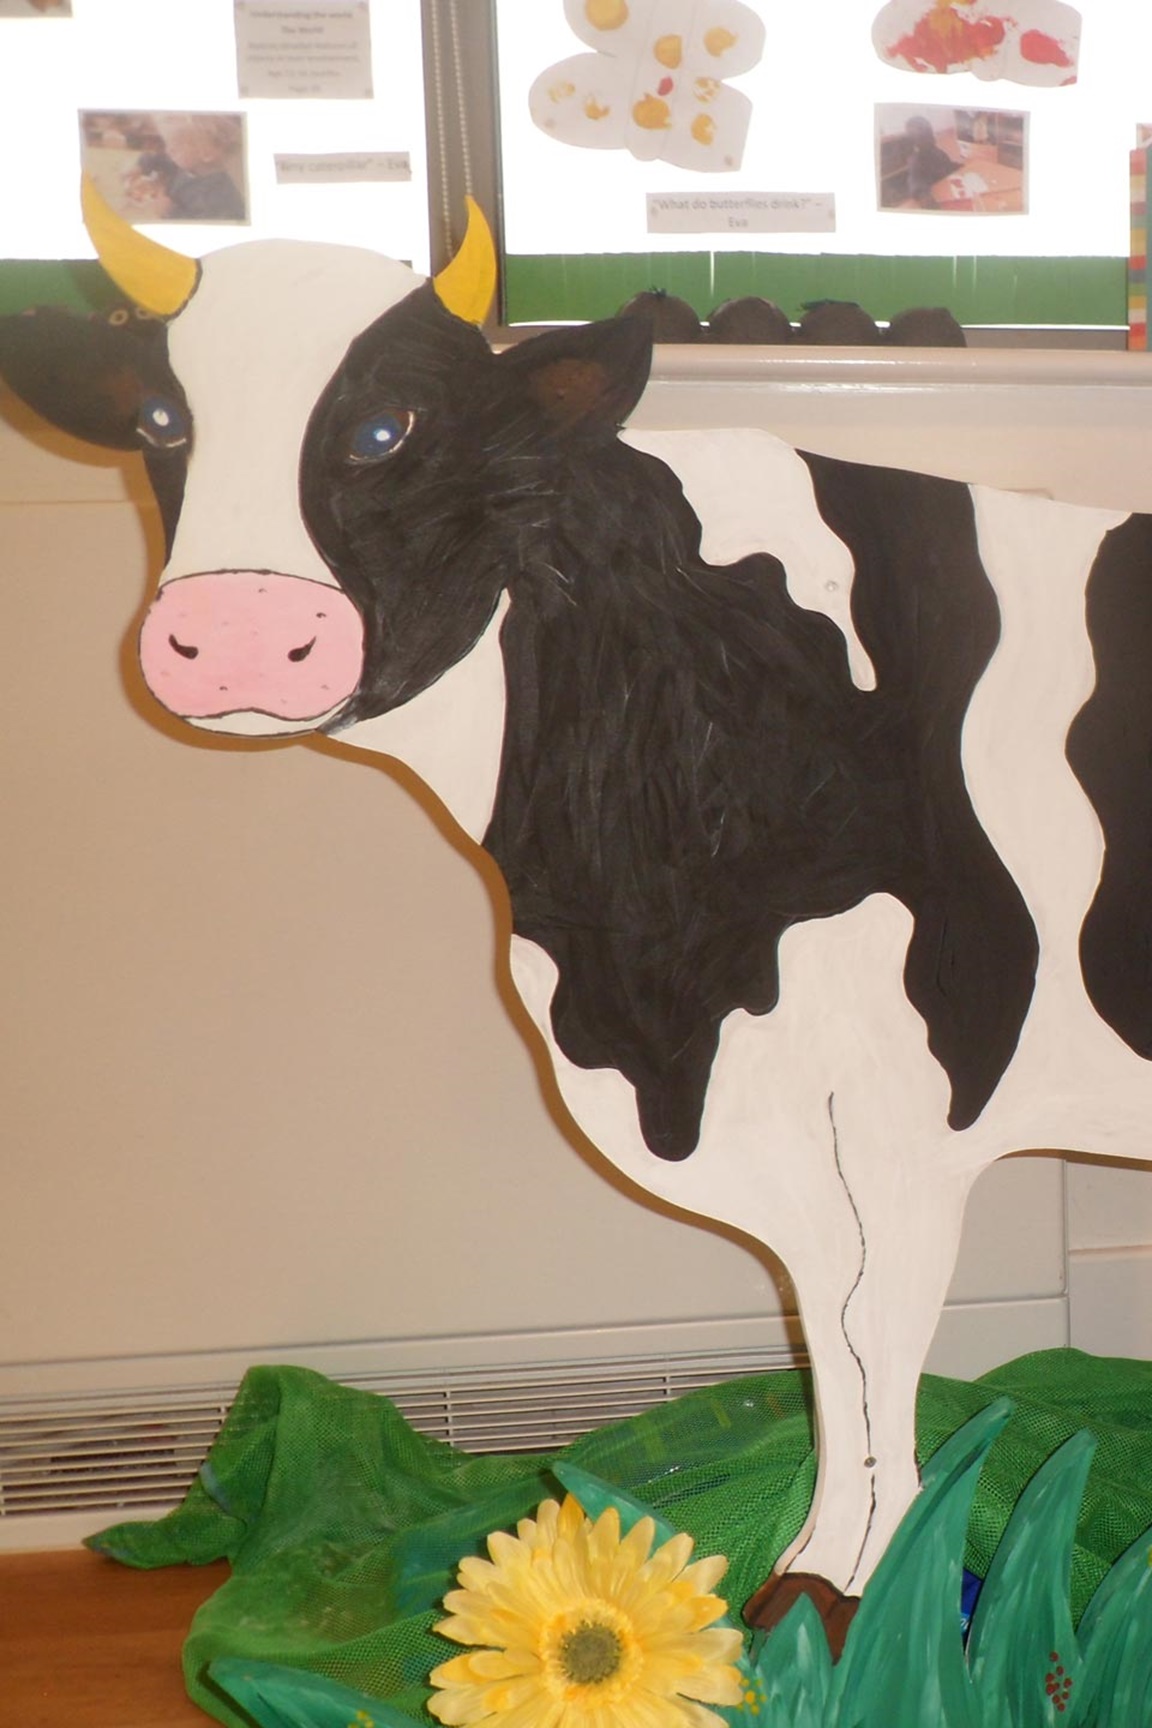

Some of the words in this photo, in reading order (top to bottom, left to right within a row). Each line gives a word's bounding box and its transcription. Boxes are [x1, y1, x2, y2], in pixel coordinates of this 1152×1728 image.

[653, 199, 689, 210] "What
[691, 199, 707, 210] do
[709, 199, 769, 210] butterflies
[728, 216, 749, 228] Eva
